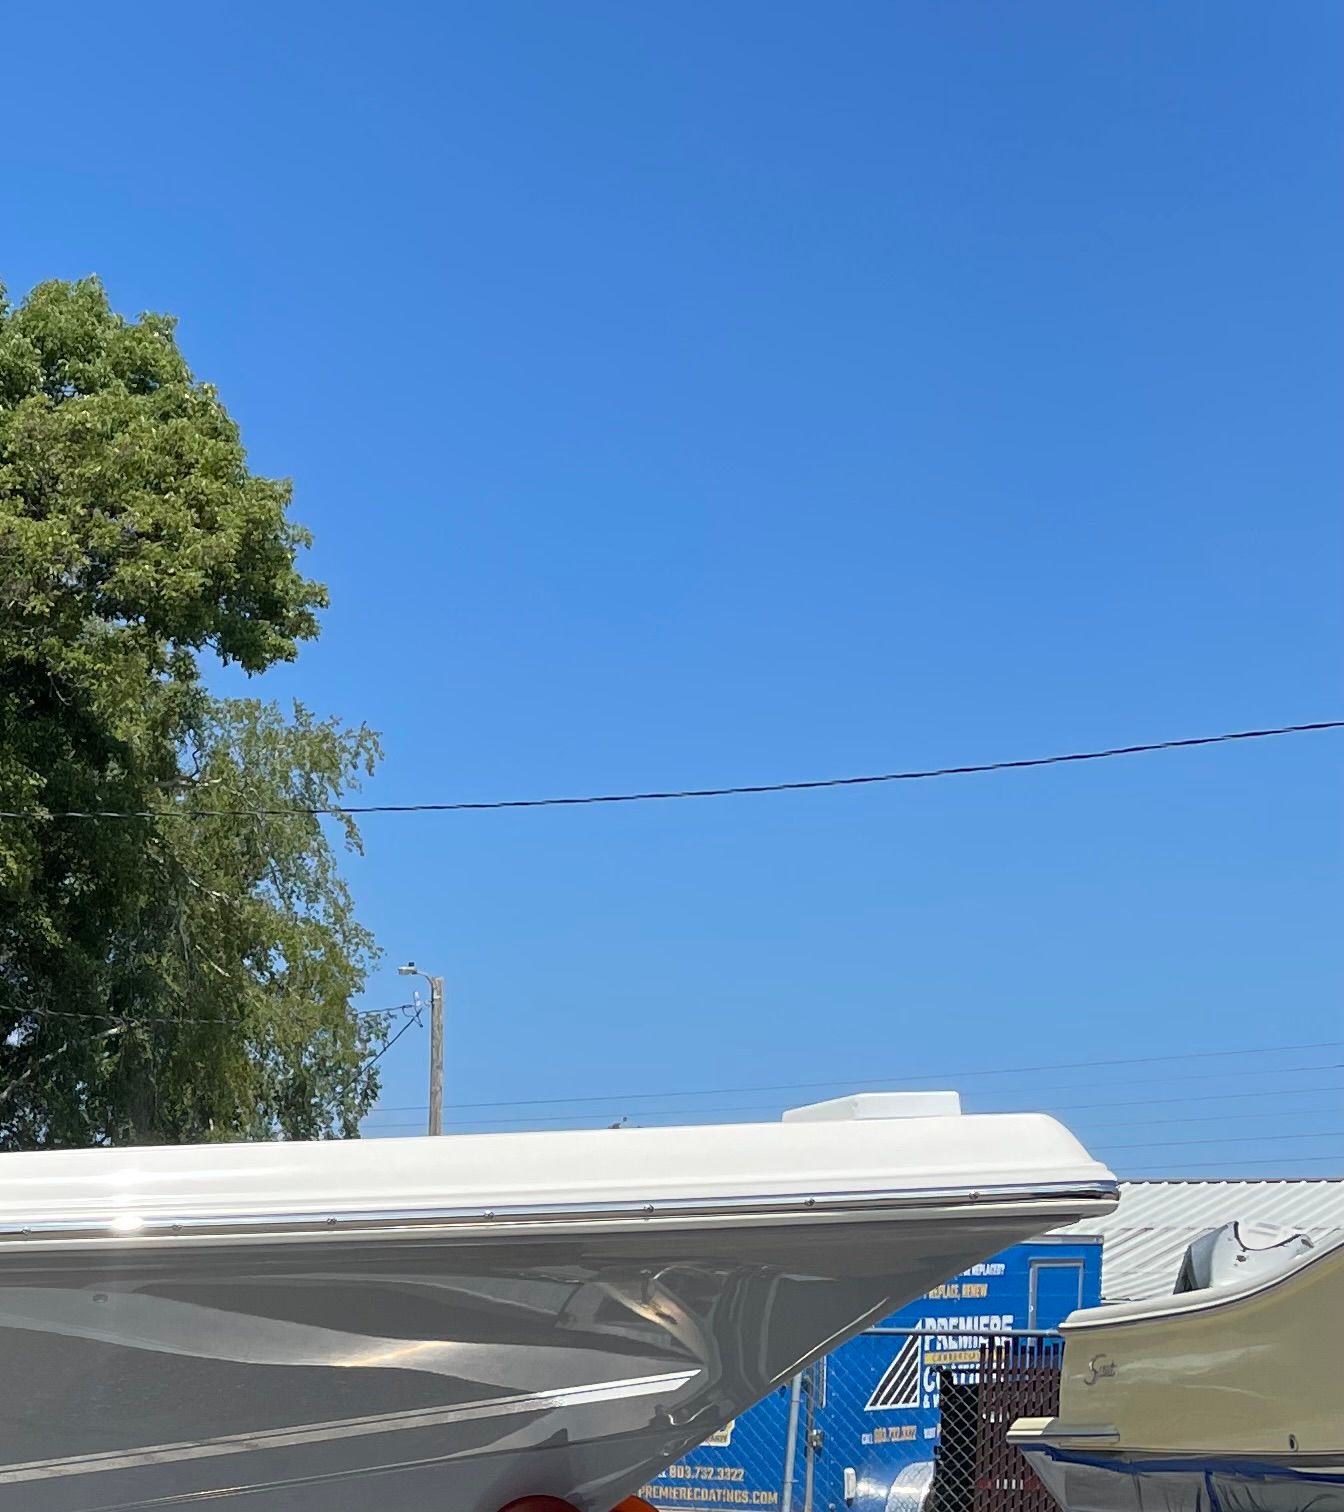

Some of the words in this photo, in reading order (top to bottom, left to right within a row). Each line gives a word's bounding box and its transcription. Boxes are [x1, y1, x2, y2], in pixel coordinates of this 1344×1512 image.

[924, 1314, 1015, 1351] PREMIERE
[668, 1464, 745, 1482] 803.732.3322
[638, 1483, 779, 1506] PREMIERECOATINGS.COM
